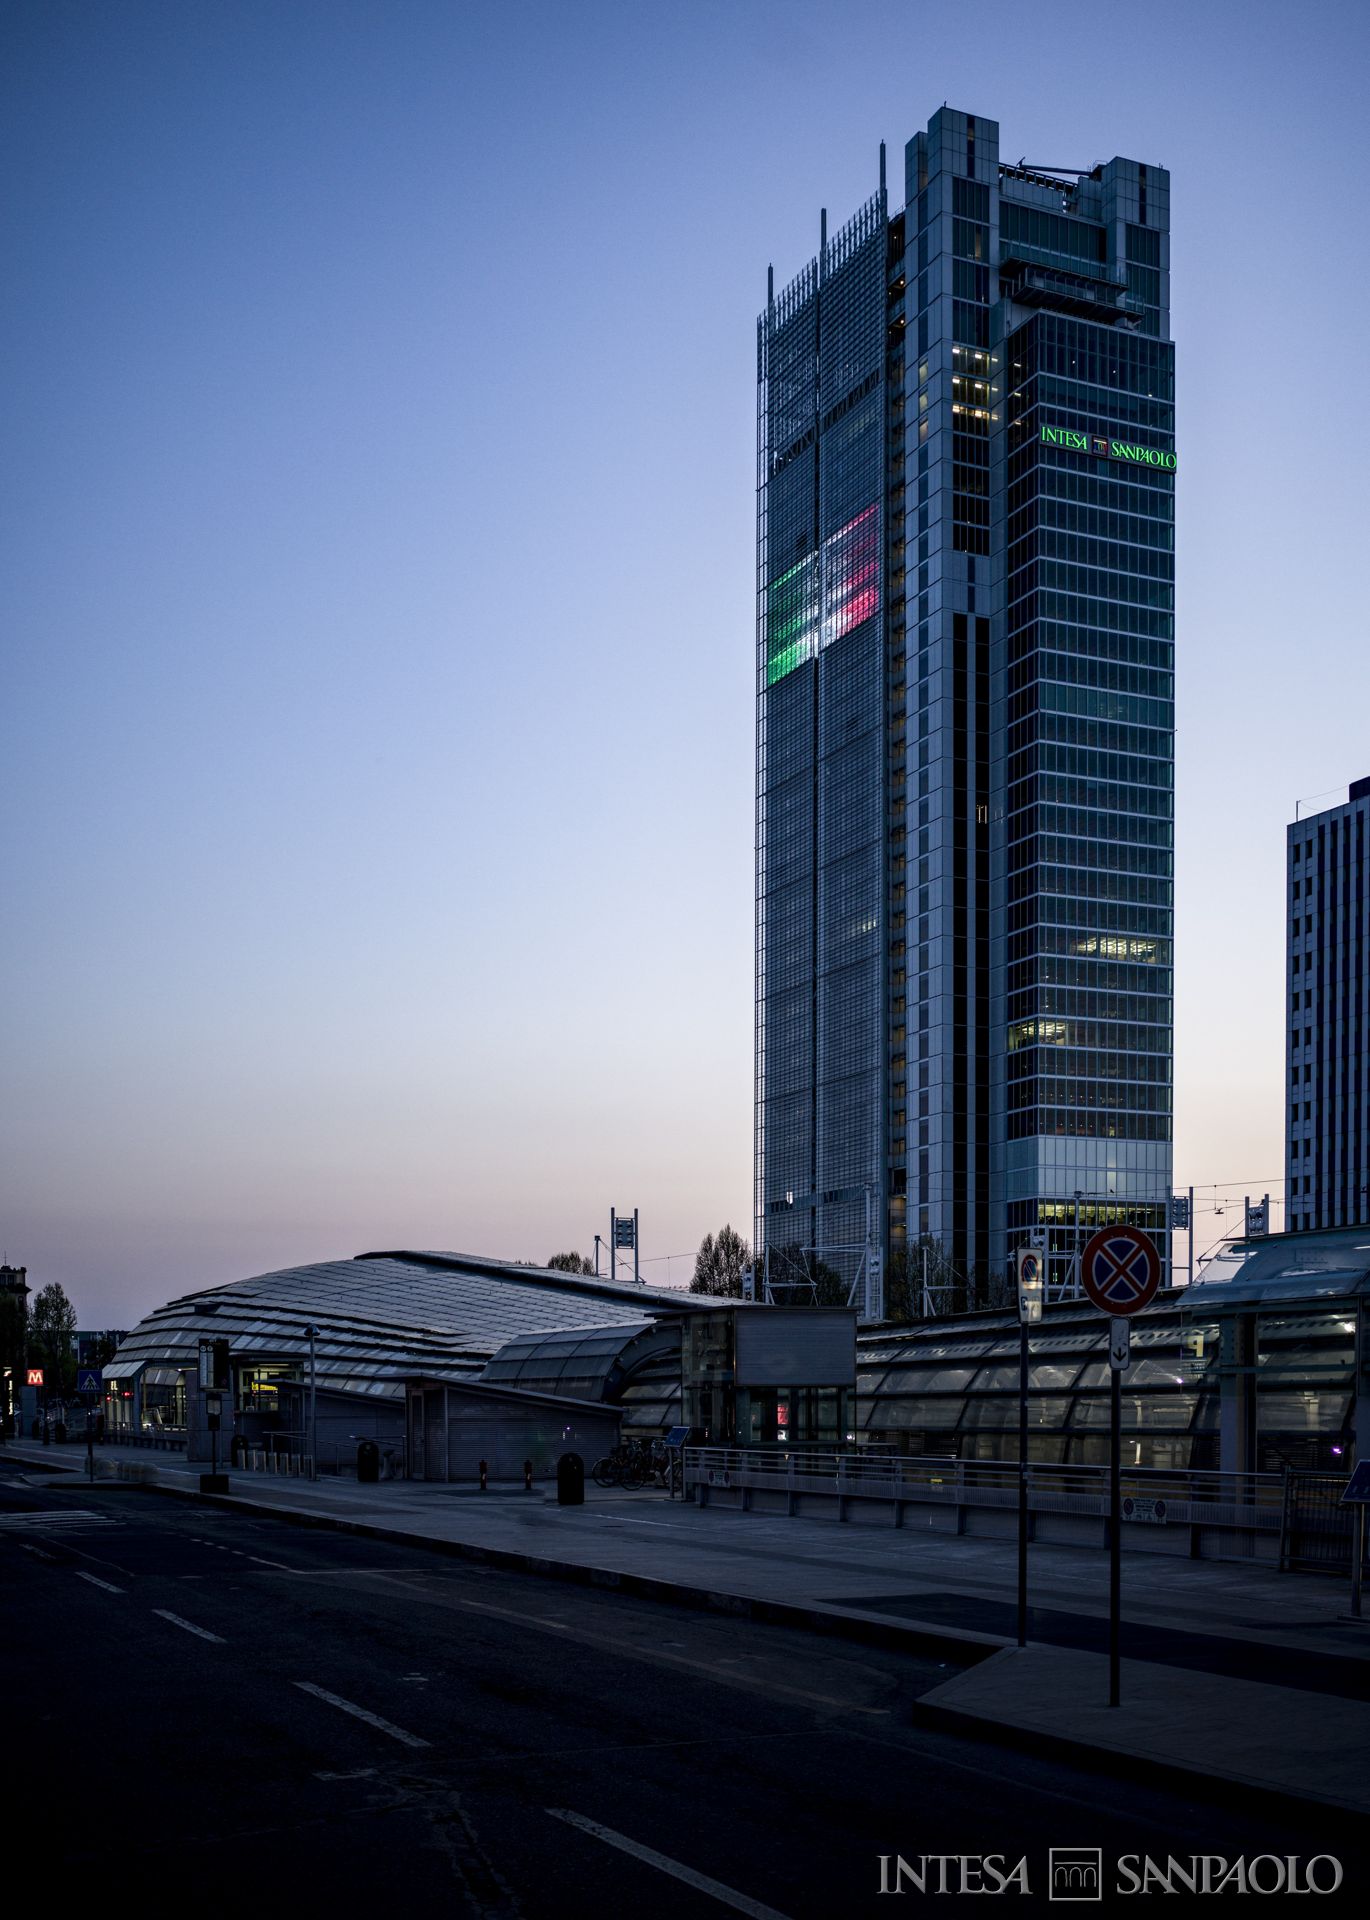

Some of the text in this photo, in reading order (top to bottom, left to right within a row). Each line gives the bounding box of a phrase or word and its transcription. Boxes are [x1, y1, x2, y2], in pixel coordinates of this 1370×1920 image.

[1041, 426, 1177, 469] INTESA SANPAOLO
[28, 1372, 44, 1383] M
